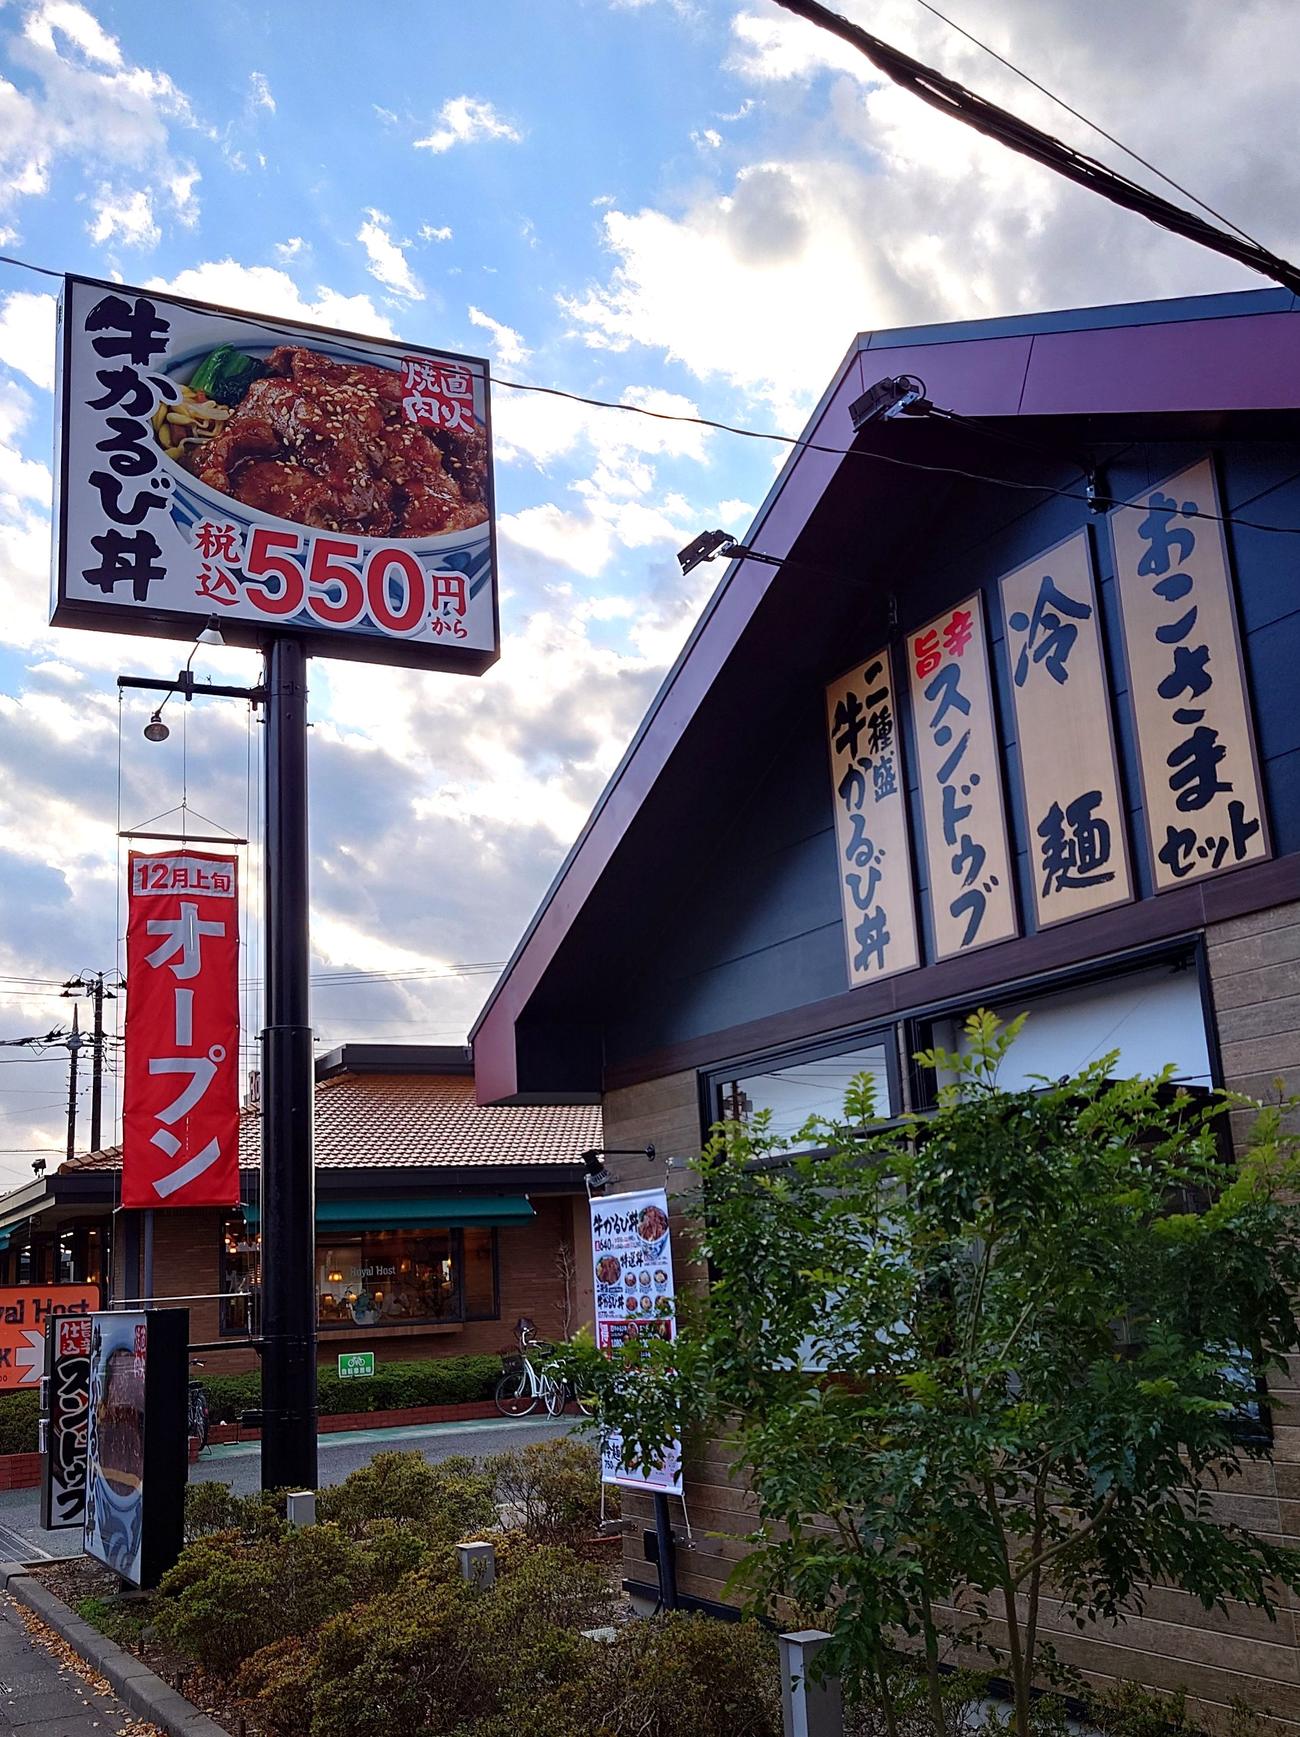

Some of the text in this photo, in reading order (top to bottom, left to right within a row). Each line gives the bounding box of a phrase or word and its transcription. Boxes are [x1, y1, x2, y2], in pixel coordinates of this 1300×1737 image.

[82, 295, 178, 602] 牛かるび丼
[401, 361, 441, 424] 焼肉
[440, 365, 475, 433] 直火
[194, 521, 468, 638] 税込 550 円 から
[864, 660, 898, 803] 二種盛
[1008, 575, 1115, 898] 冷麺
[1137, 491, 1260, 877] おこさま セット
[137, 863, 231, 892] 12月上旬
[831, 691, 890, 972] 牛かるび丼
[144, 901, 226, 1199] オープン
[375, 1264, 396, 1276] Host
[593, 1209, 639, 1236] 牛かるび丼
[61, 1322, 80, 1355] 仕込
